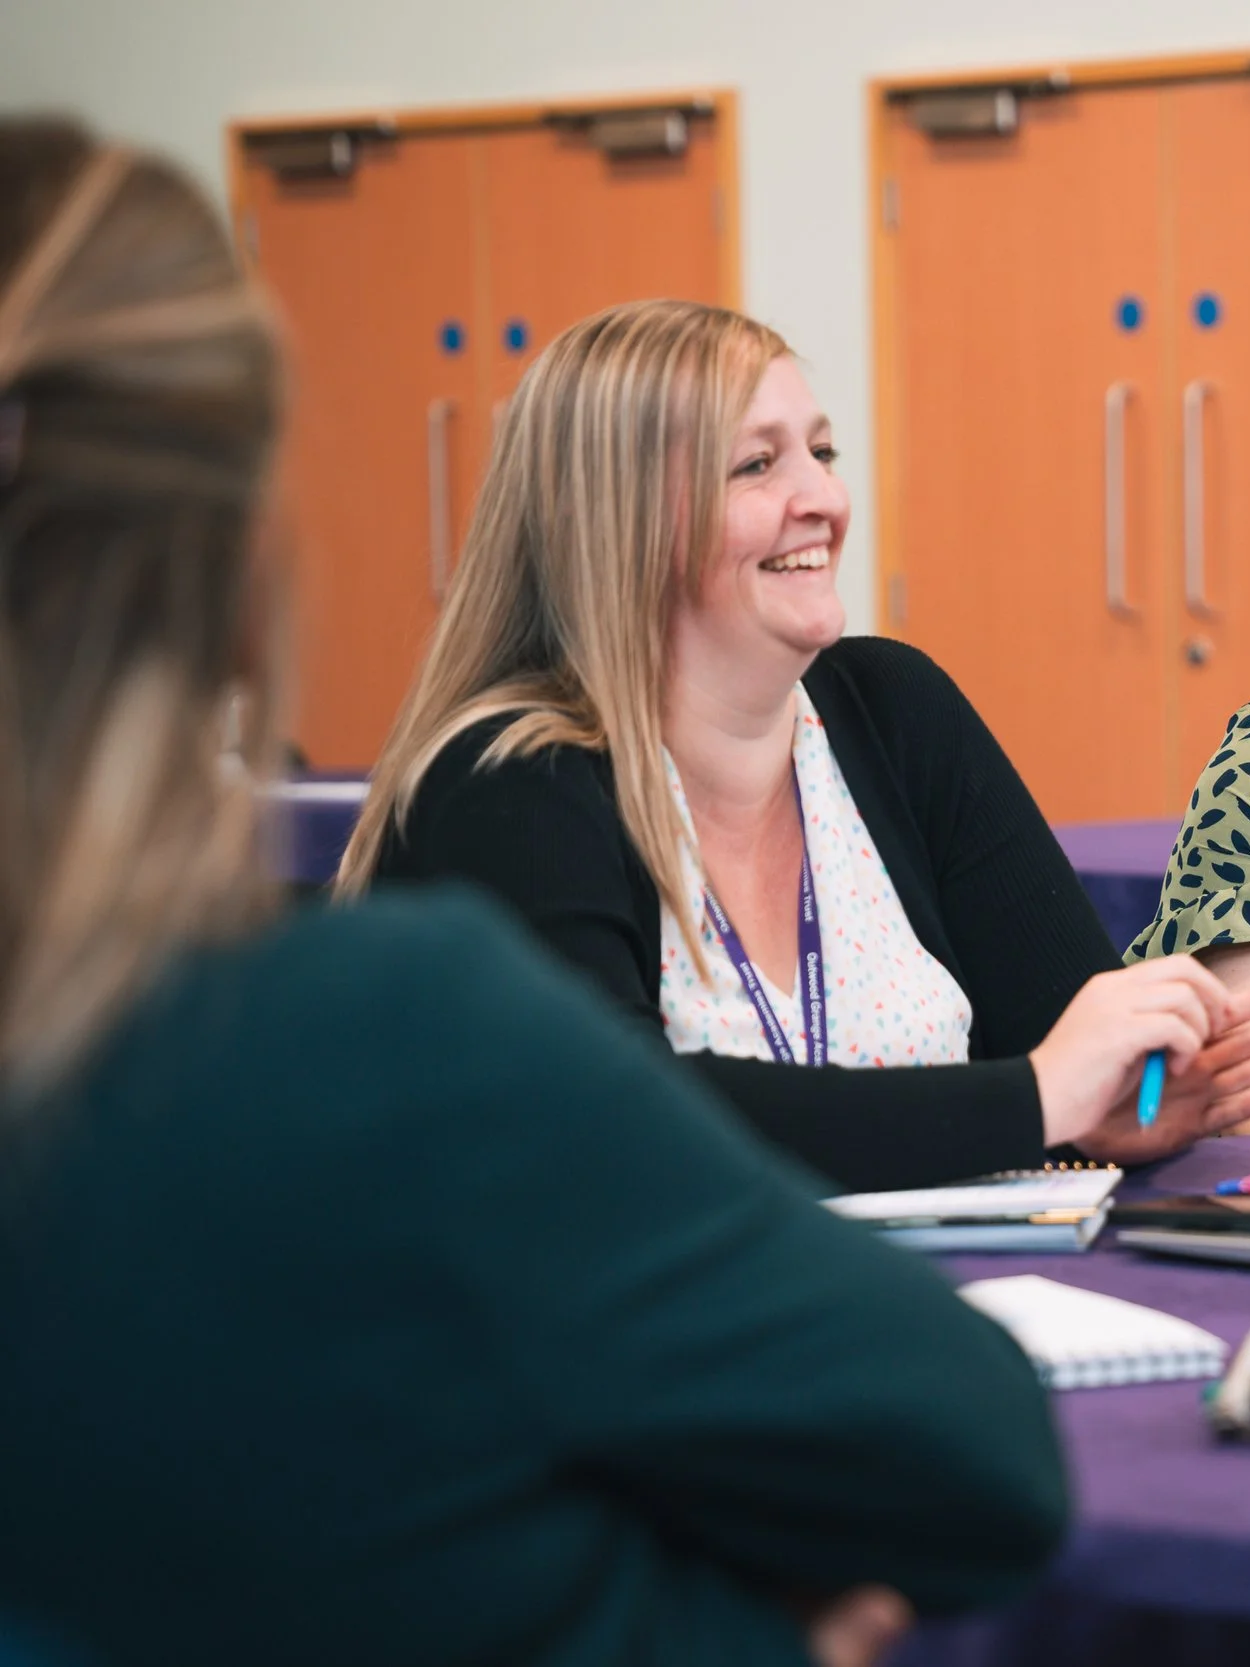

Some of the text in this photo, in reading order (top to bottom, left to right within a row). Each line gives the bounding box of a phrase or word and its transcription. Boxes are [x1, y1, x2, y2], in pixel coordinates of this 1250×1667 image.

[803, 894, 814, 922] Trust
[740, 961, 758, 991] Trust
[806, 951, 820, 1000] Outwood
[753, 989, 784, 1046] Academies
[810, 1001, 823, 1041] Grange
